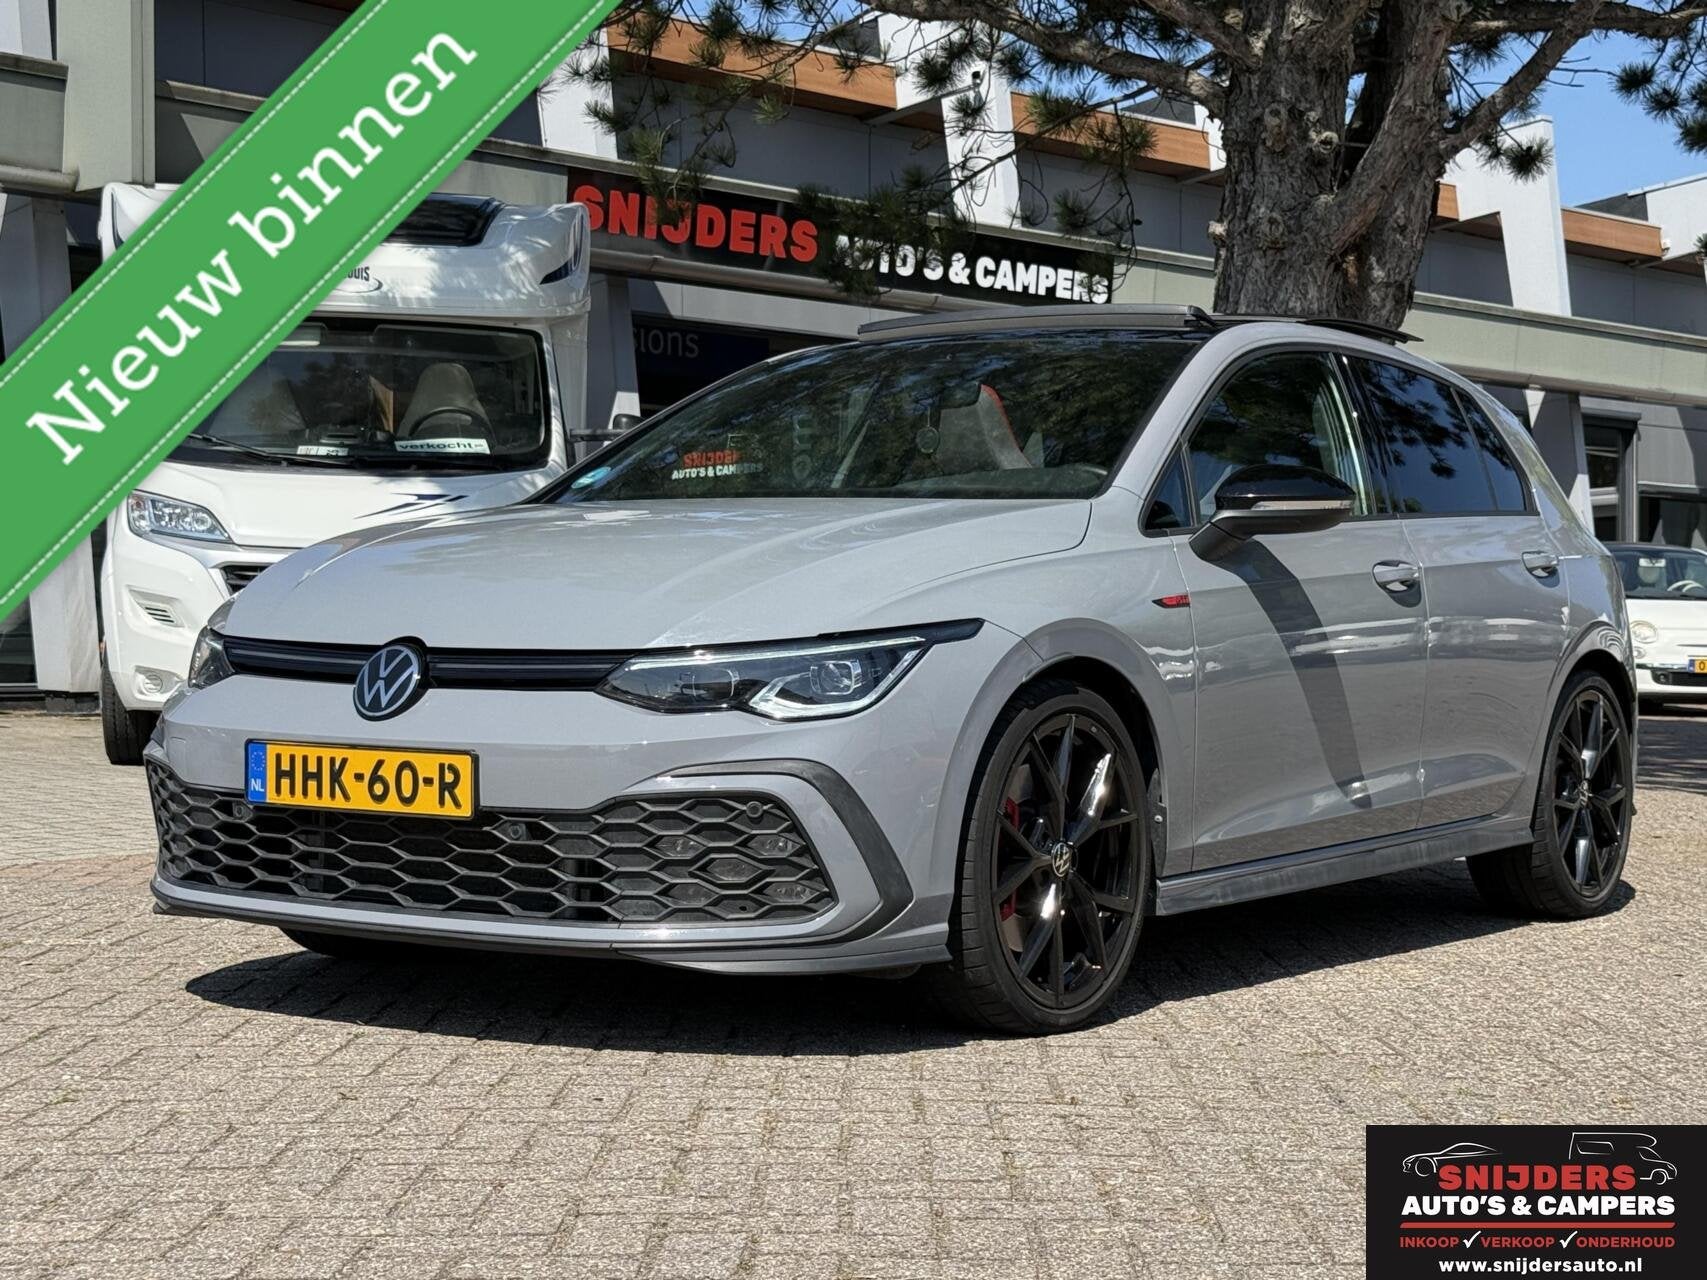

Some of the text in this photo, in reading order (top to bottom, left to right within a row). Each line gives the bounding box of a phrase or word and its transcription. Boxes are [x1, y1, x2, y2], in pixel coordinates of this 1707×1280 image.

[573, 185, 818, 263] SNIJDERS
[948, 252, 970, 285] &
[975, 256, 1109, 304] CAMPERS
[633, 327, 700, 359] ions
[399, 442, 472, 450] verkocht
[671, 465, 707, 480] AUTO'S
[250, 752, 463, 810] NL HHK-60-R
